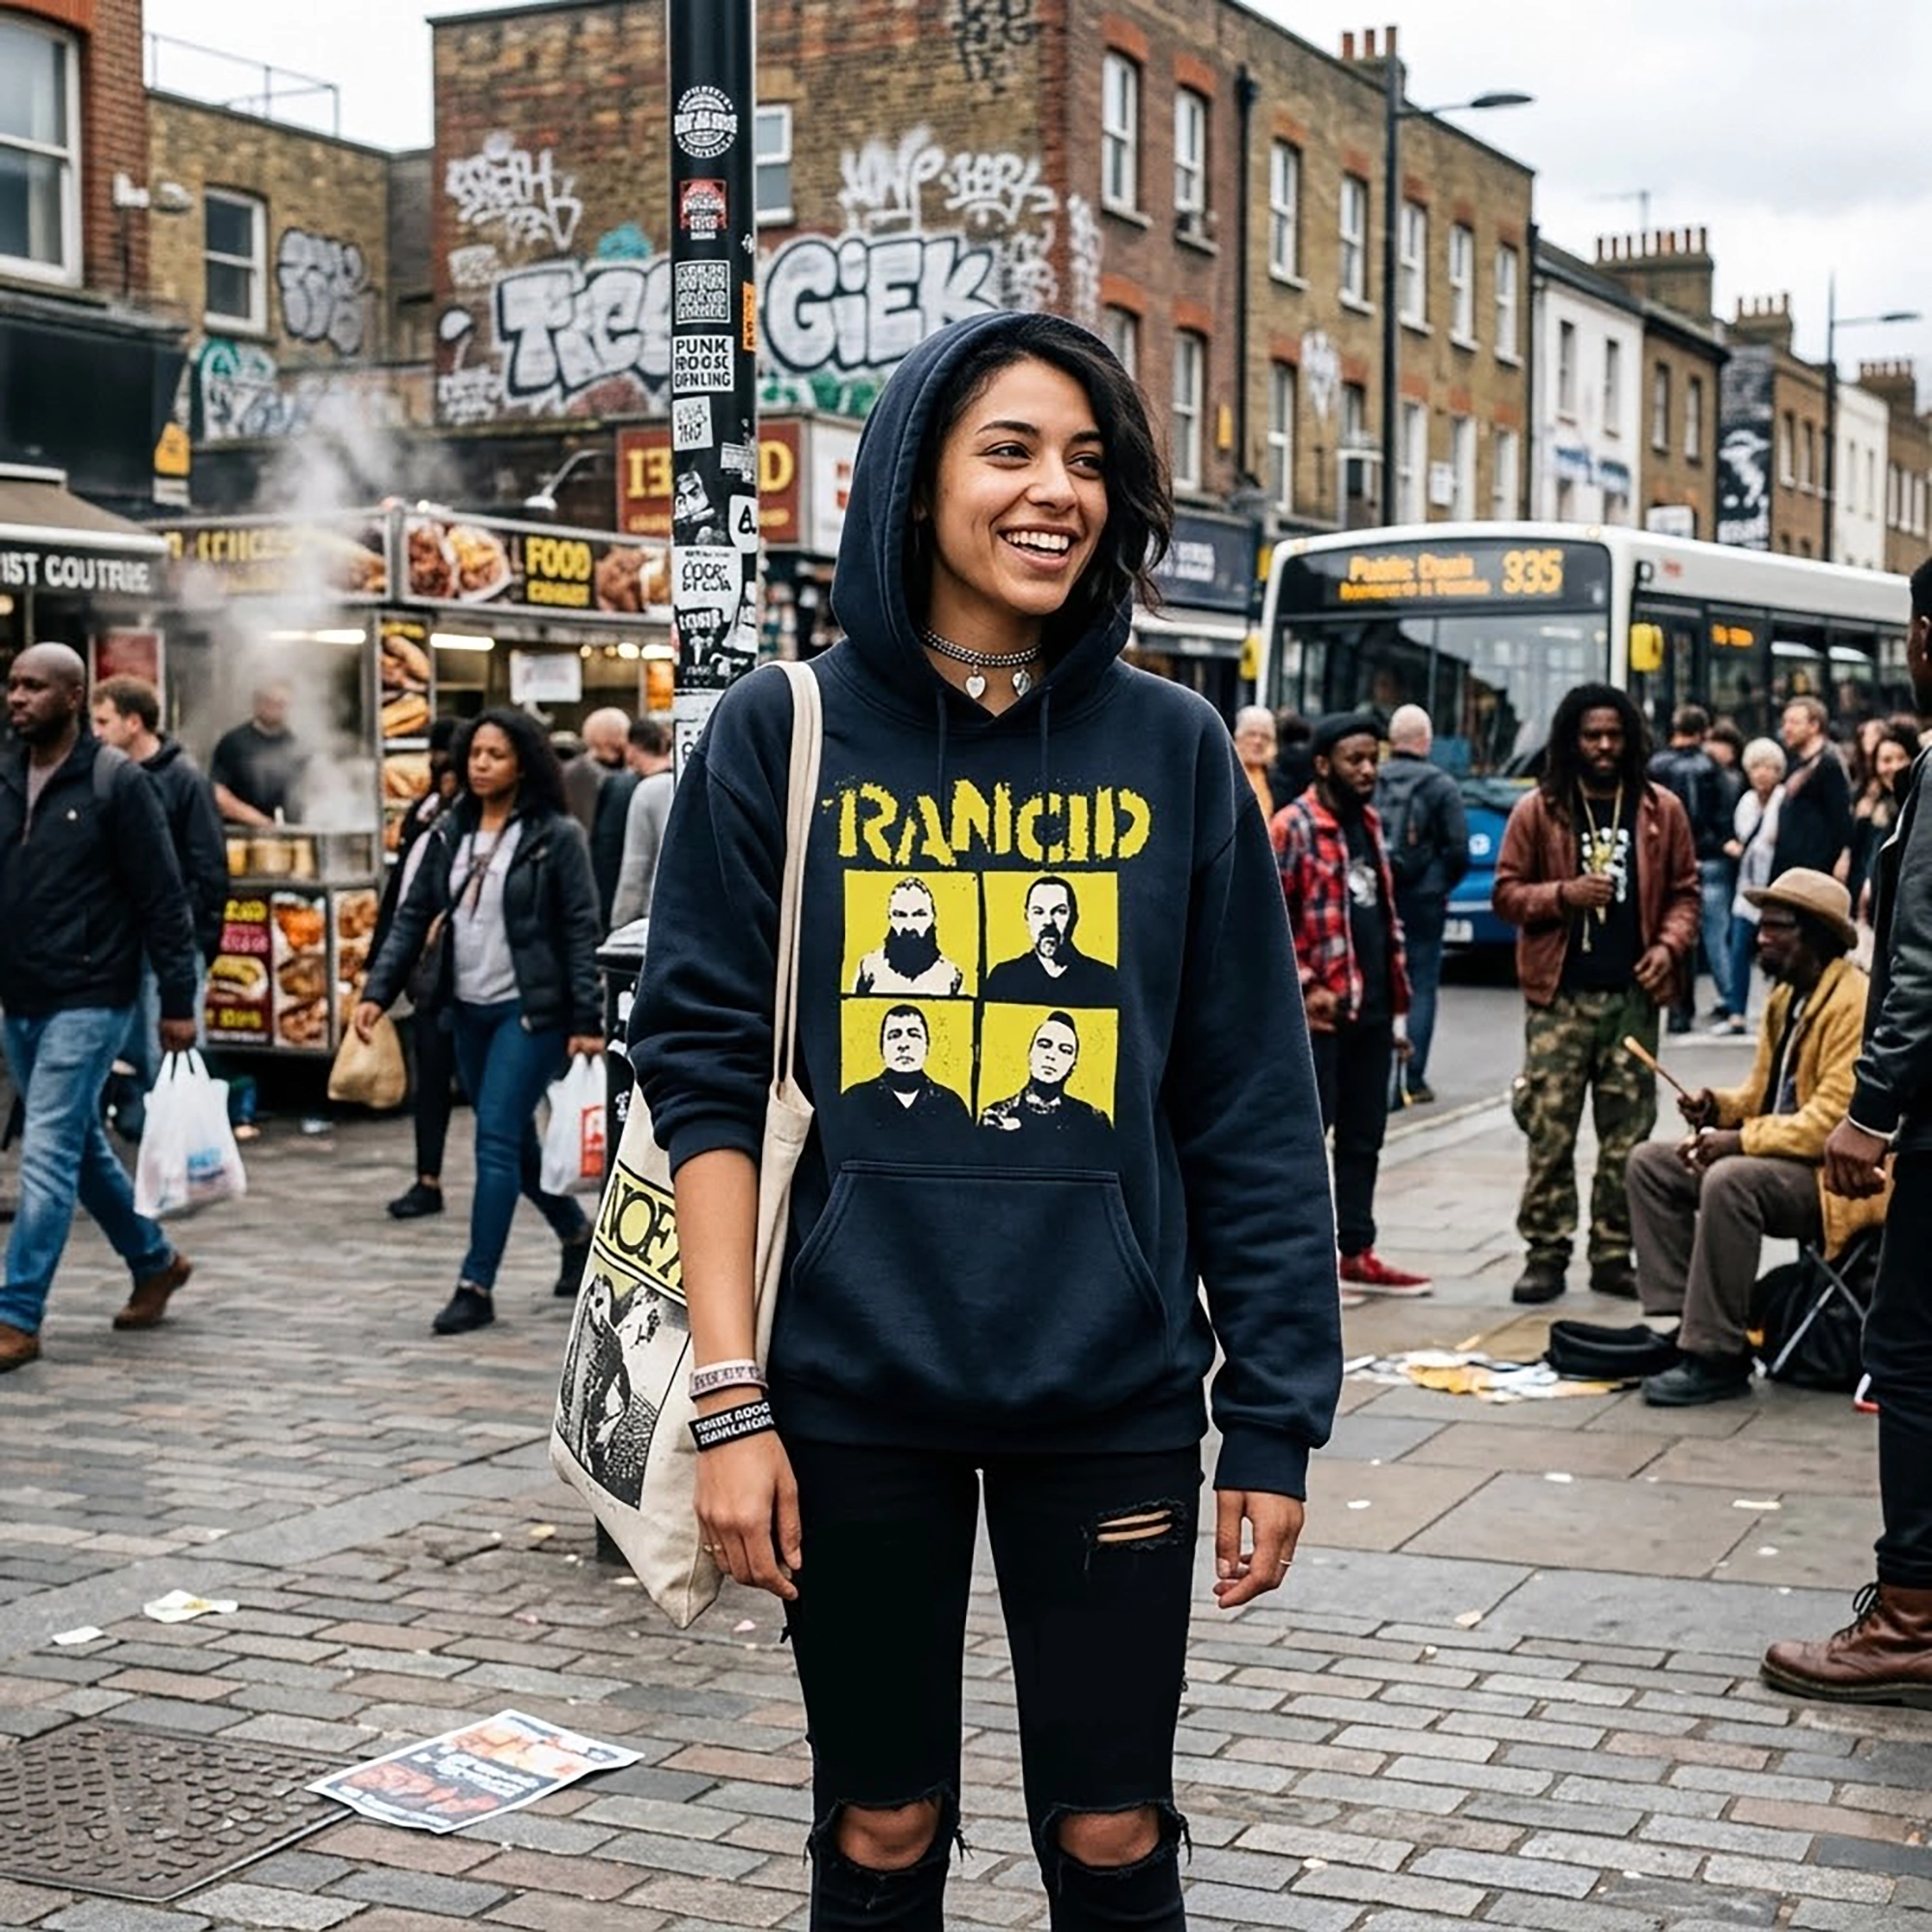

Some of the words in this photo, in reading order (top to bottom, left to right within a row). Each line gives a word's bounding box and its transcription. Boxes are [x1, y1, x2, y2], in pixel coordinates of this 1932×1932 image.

[676, 339, 728, 354] PUNK
[526, 536, 592, 582] FOOD
[838, 779, 1151, 867] RANCID
